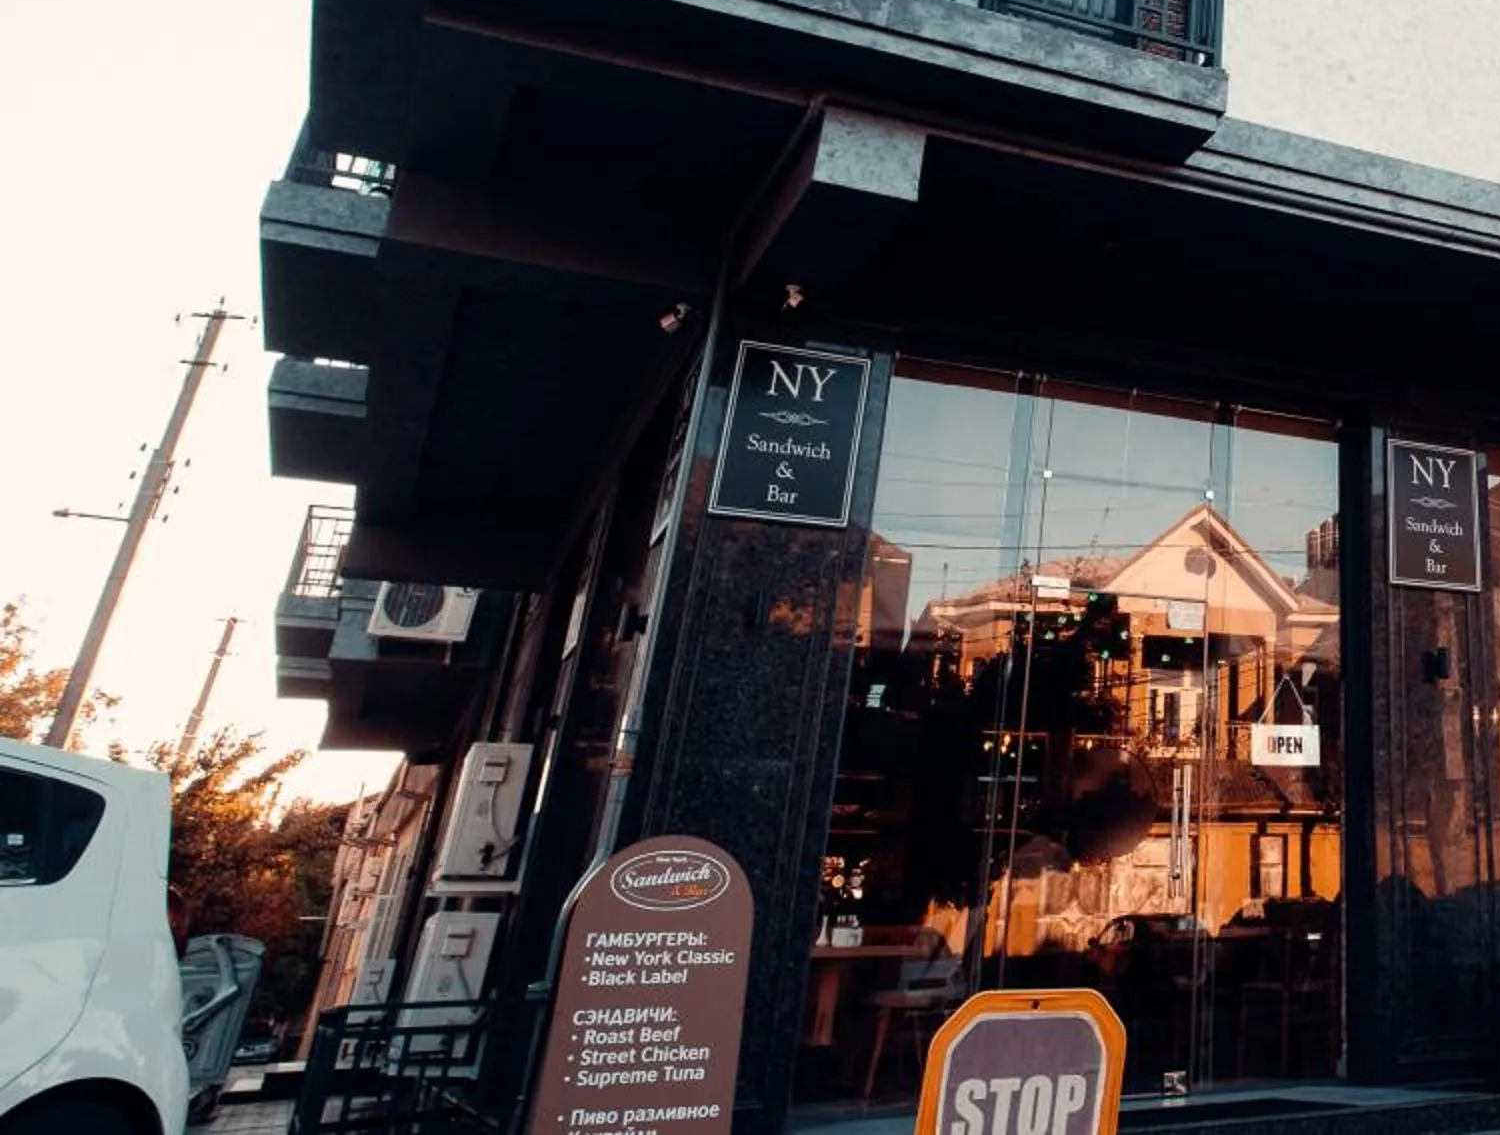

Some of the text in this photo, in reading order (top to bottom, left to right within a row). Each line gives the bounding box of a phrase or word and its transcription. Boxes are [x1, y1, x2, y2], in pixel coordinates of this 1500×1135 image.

[766, 360, 837, 402] NY
[746, 432, 832, 460] Sandwich
[775, 461, 795, 480] &
[1409, 454, 1456, 488] NY
[765, 484, 799, 504] Bar
[1405, 516, 1463, 536] Sandwich
[1429, 538, 1444, 554] &
[1425, 558, 1447, 574] Bar
[1267, 736, 1303, 754] OPEN
[620, 861, 712, 890] Sandwich
[585, 931, 709, 948] ГАМБУРГЕРЫ:
[592, 949, 735, 966] New York Classic
[588, 968, 687, 986] Black Label
[572, 1007, 678, 1026] СЭНДВИЧИ:
[583, 1026, 681, 1045] Roast Beef
[579, 1045, 710, 1065] Street Chicken
[576, 1065, 706, 1089] Supreme Tuna
[951, 1074, 1087, 1135] STOP
[570, 1104, 721, 1126] Пиво разливное
